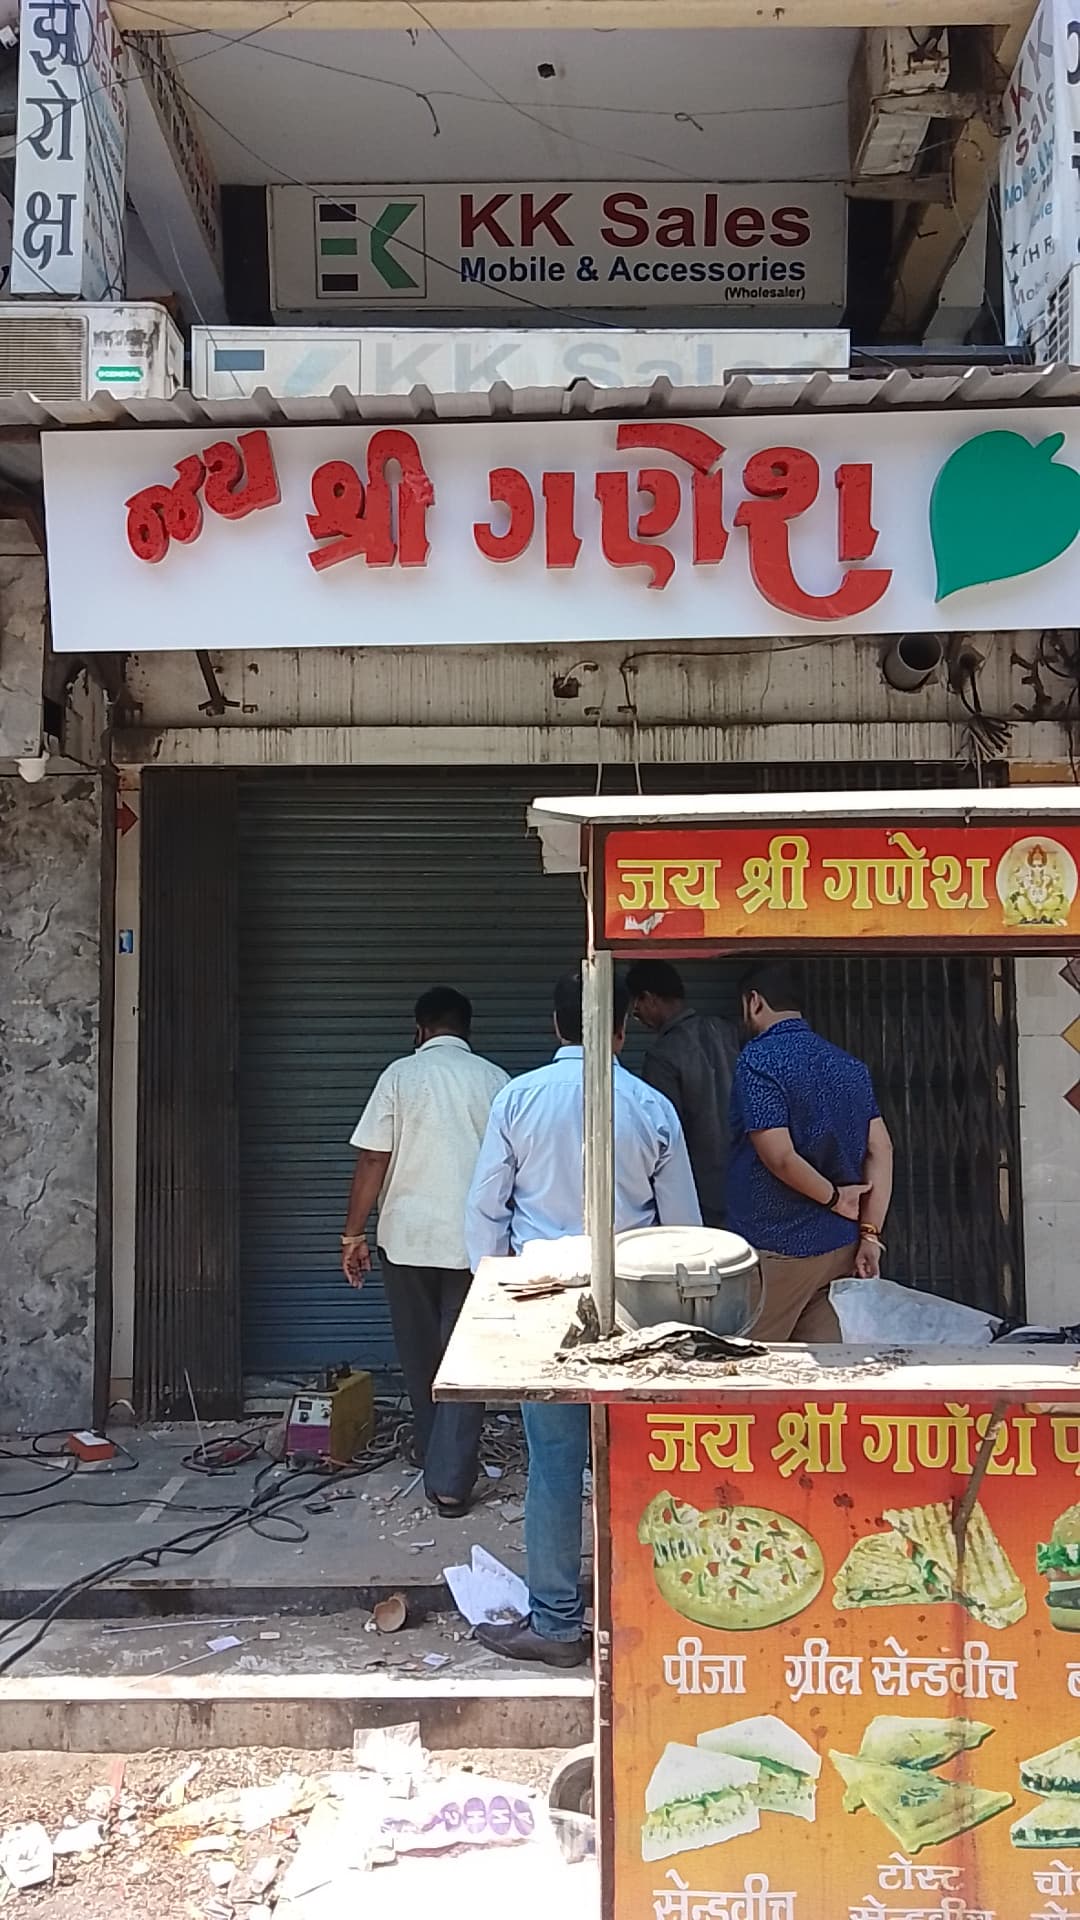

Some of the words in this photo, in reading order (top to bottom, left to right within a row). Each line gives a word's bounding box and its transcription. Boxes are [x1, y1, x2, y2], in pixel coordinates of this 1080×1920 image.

[459, 193, 575, 249] KK
[600, 192, 812, 248] Sales
[460, 256, 566, 284] Mobile
[576, 256, 599, 283] &
[608, 256, 806, 283] Accessories
[724, 286, 806, 301] (Wholesaler)
[126, 430, 281, 563] જય
[473, 423, 893, 622] ગણેશ
[617, 858, 722, 910] जय
[736, 835, 811, 914] श्री
[822, 832, 991, 910] गणेश
[647, 1414, 755, 1473] जय
[663, 1636, 747, 1695] पीजा
[784, 1637, 863, 1702] ग्रील
[1032, 1859, 1080, 1896] चो
